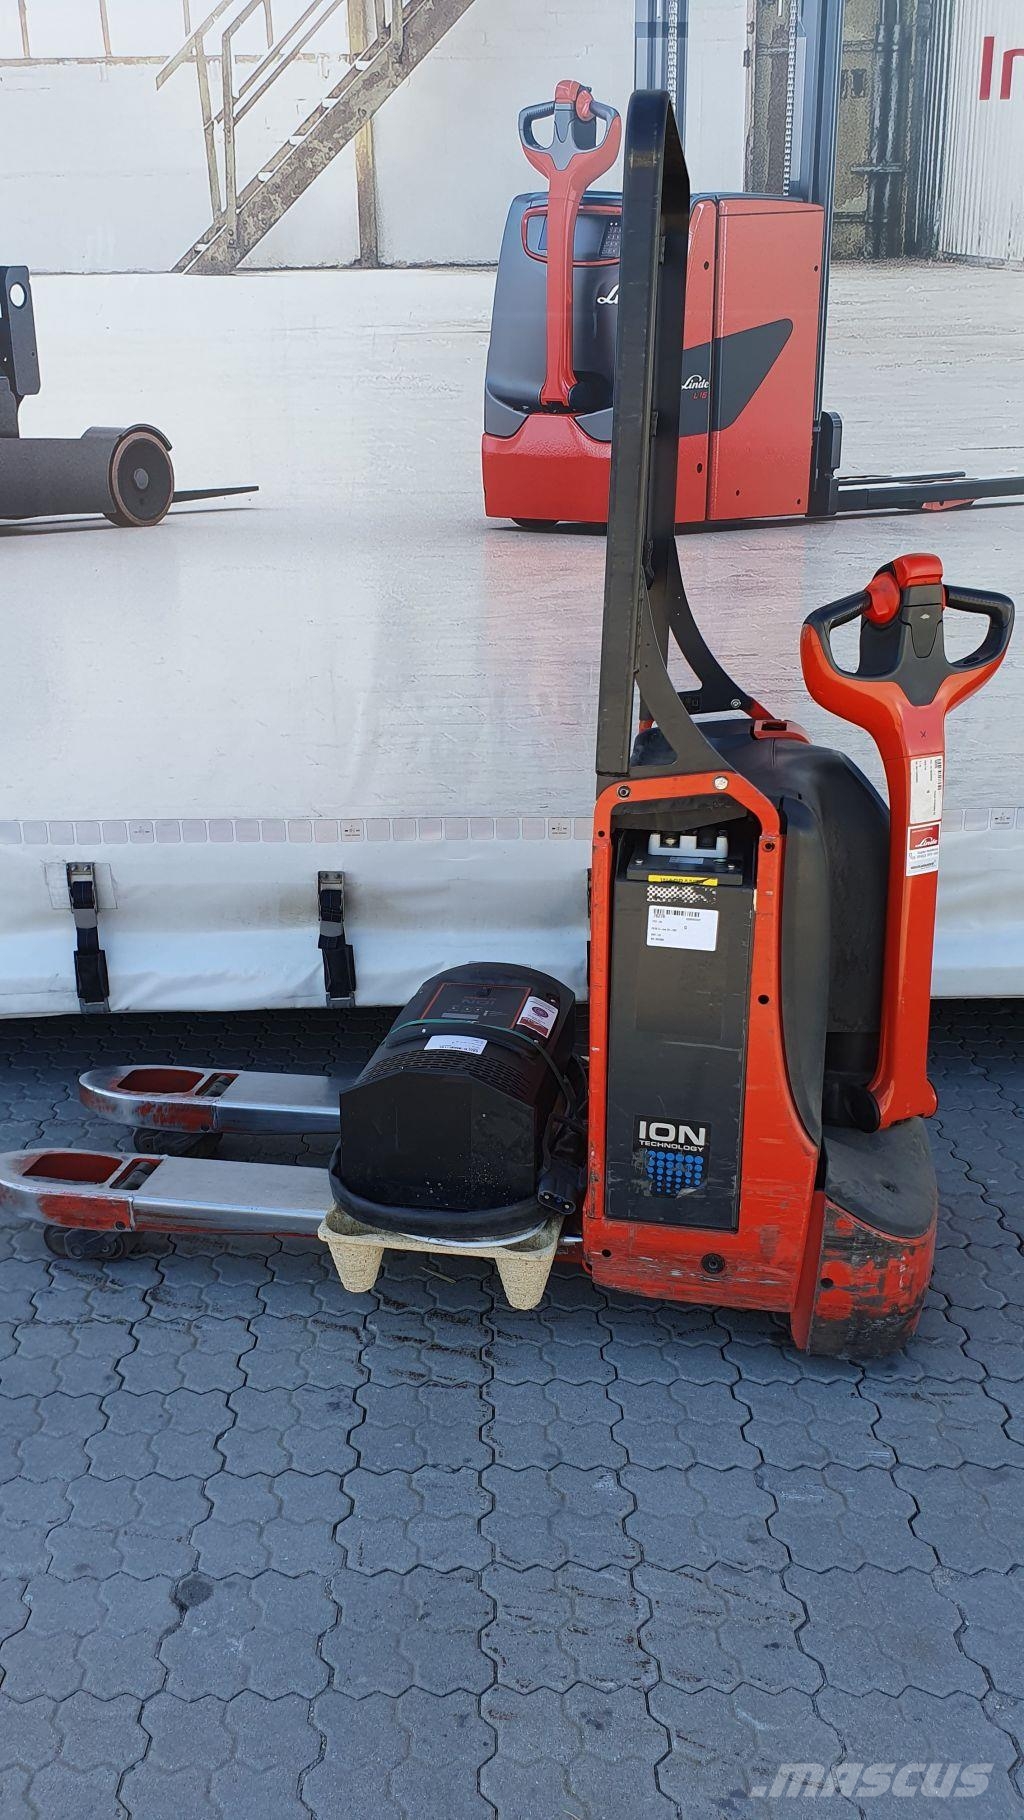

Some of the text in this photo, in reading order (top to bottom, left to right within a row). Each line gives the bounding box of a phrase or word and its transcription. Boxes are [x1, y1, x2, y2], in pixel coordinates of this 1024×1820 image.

[681, 374, 709, 389] Linde
[639, 1121, 706, 1146] ION
[639, 1140, 704, 1153] TECHNOLOGY
